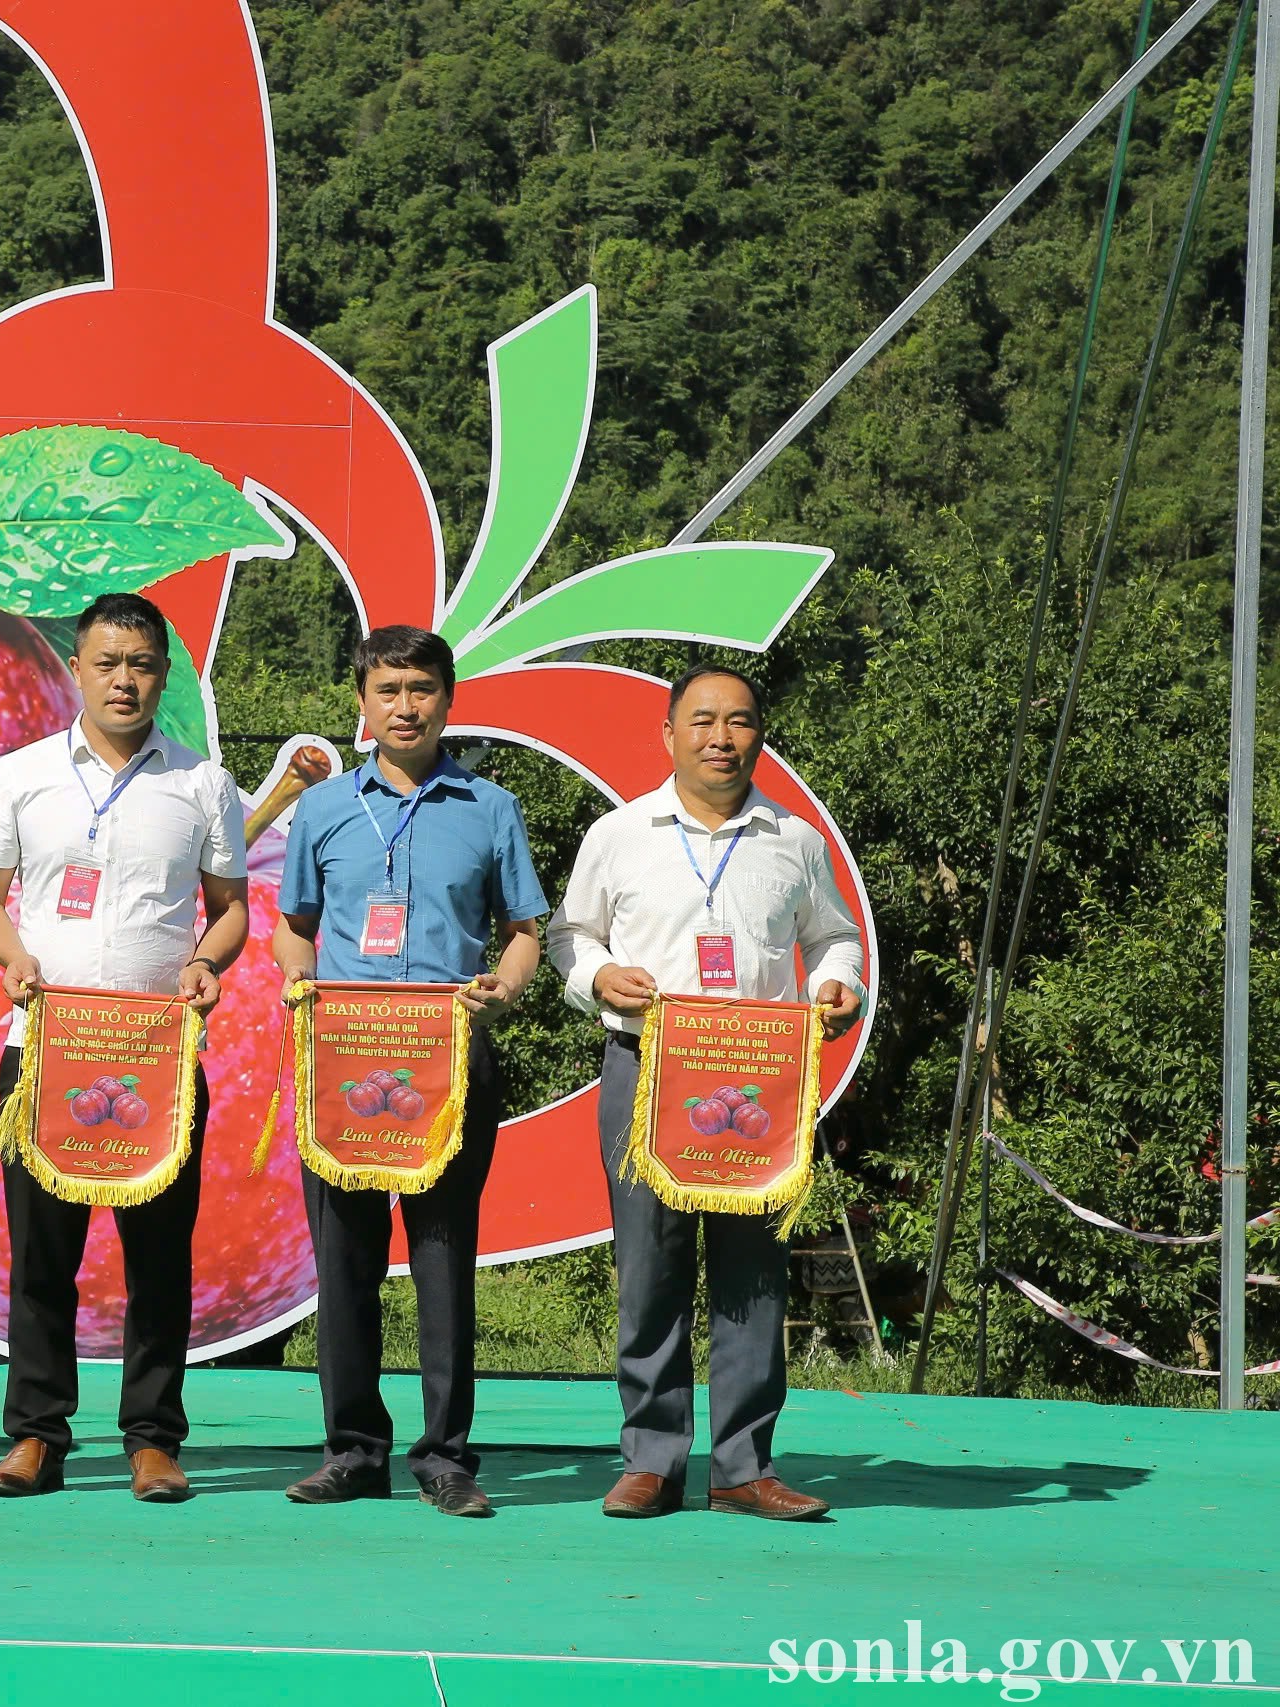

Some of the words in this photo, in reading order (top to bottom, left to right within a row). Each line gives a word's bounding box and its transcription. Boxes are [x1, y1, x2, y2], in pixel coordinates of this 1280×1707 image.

[55, 1006, 92, 1021] BAN
[97, 1004, 121, 1024] TỔ
[324, 1002, 362, 1016] BAN
[367, 997, 391, 1017] TỔ
[395, 1002, 443, 1019] CHỨC
[347, 1021, 369, 1031] NGÀY
[371, 1022, 384, 1033] HỘI
[386, 1022, 400, 1032] HÁI
[402, 1022, 419, 1033] QUẢ
[674, 1015, 712, 1029] BAN
[717, 1012, 741, 1032] TỔ
[745, 1018, 794, 1035] CHỨC
[77, 1026, 98, 1036] NGÀY
[100, 1028, 114, 1039] HỘI
[116, 1029, 129, 1039] HÁI
[320, 1033, 340, 1044] MẬN
[341, 1034, 357, 1045] HẬU
[359, 1035, 377, 1046] MỘC
[379, 1036, 401, 1045] CHÂU
[420, 1036, 436, 1046] THỨ
[50, 1037, 69, 1048] MẬN
[148, 1043, 164, 1053] THỨ
[696, 1034, 719, 1045] NGÀY
[720, 1036, 734, 1047] HỘI
[736, 1037, 750, 1047] HÁI
[752, 1036, 769, 1049] QUẢ
[63, 1049, 82, 1061] THẢO
[85, 1051, 117, 1063] NGUYÊN
[118, 1055, 137, 1064] NĂM
[139, 1056, 158, 1066] 2026
[335, 1045, 356, 1055] THẢO
[357, 1047, 389, 1057] NGUYÊN
[390, 1047, 409, 1058] NĂM
[411, 1050, 431, 1059] 2026
[668, 1046, 688, 1057] MẬN
[689, 1047, 706, 1058] HẬU
[707, 1049, 726, 1060] MỘC
[728, 1049, 750, 1060] CHÂU
[770, 1052, 787, 1063] THỨ
[682, 1059, 703, 1070] THẢO
[705, 1063, 738, 1073] NGUYÊN
[739, 1064, 759, 1074] NĂM
[760, 1066, 781, 1075] 2026
[337, 1127, 373, 1143] Lưu
[379, 1129, 427, 1149] Niệm
[58, 1136, 94, 1152] Lưu
[100, 1138, 150, 1158] Niệm
[677, 1145, 715, 1161] Lưu
[720, 1147, 773, 1168] Niệm
